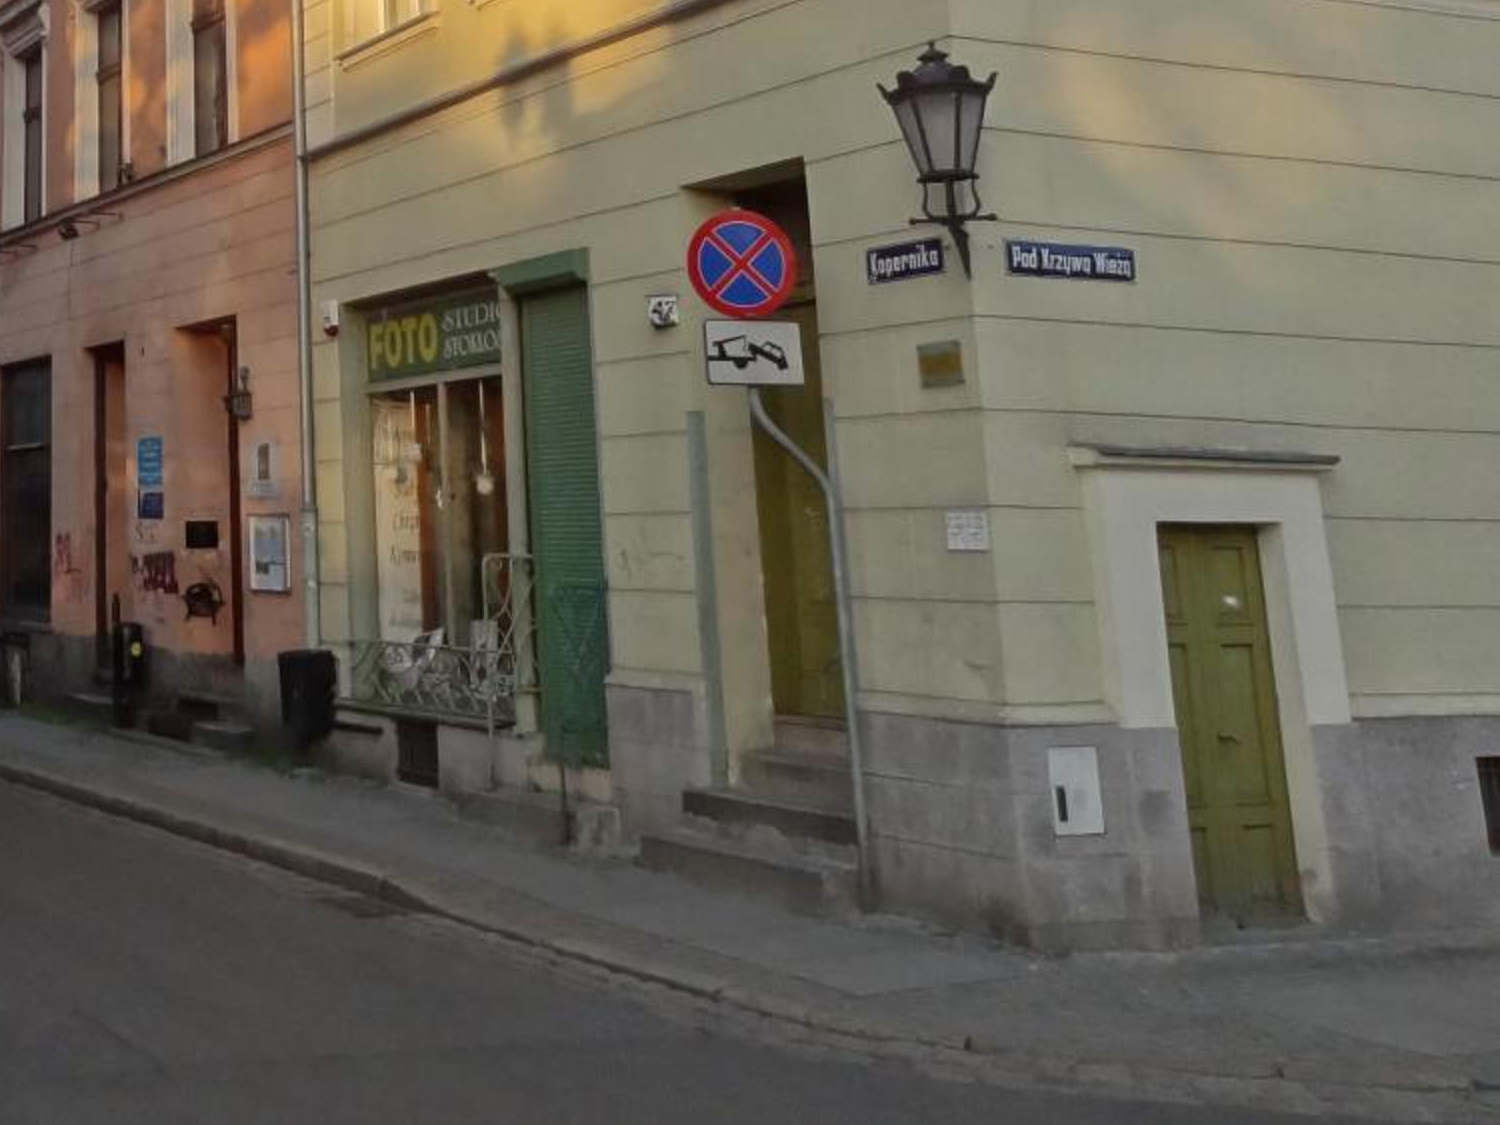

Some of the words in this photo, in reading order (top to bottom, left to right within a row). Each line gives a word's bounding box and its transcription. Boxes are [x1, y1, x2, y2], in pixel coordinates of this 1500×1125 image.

[870, 244, 939, 277] Kopernika
[1011, 246, 1037, 268] Pod
[370, 312, 439, 371] FOTO
